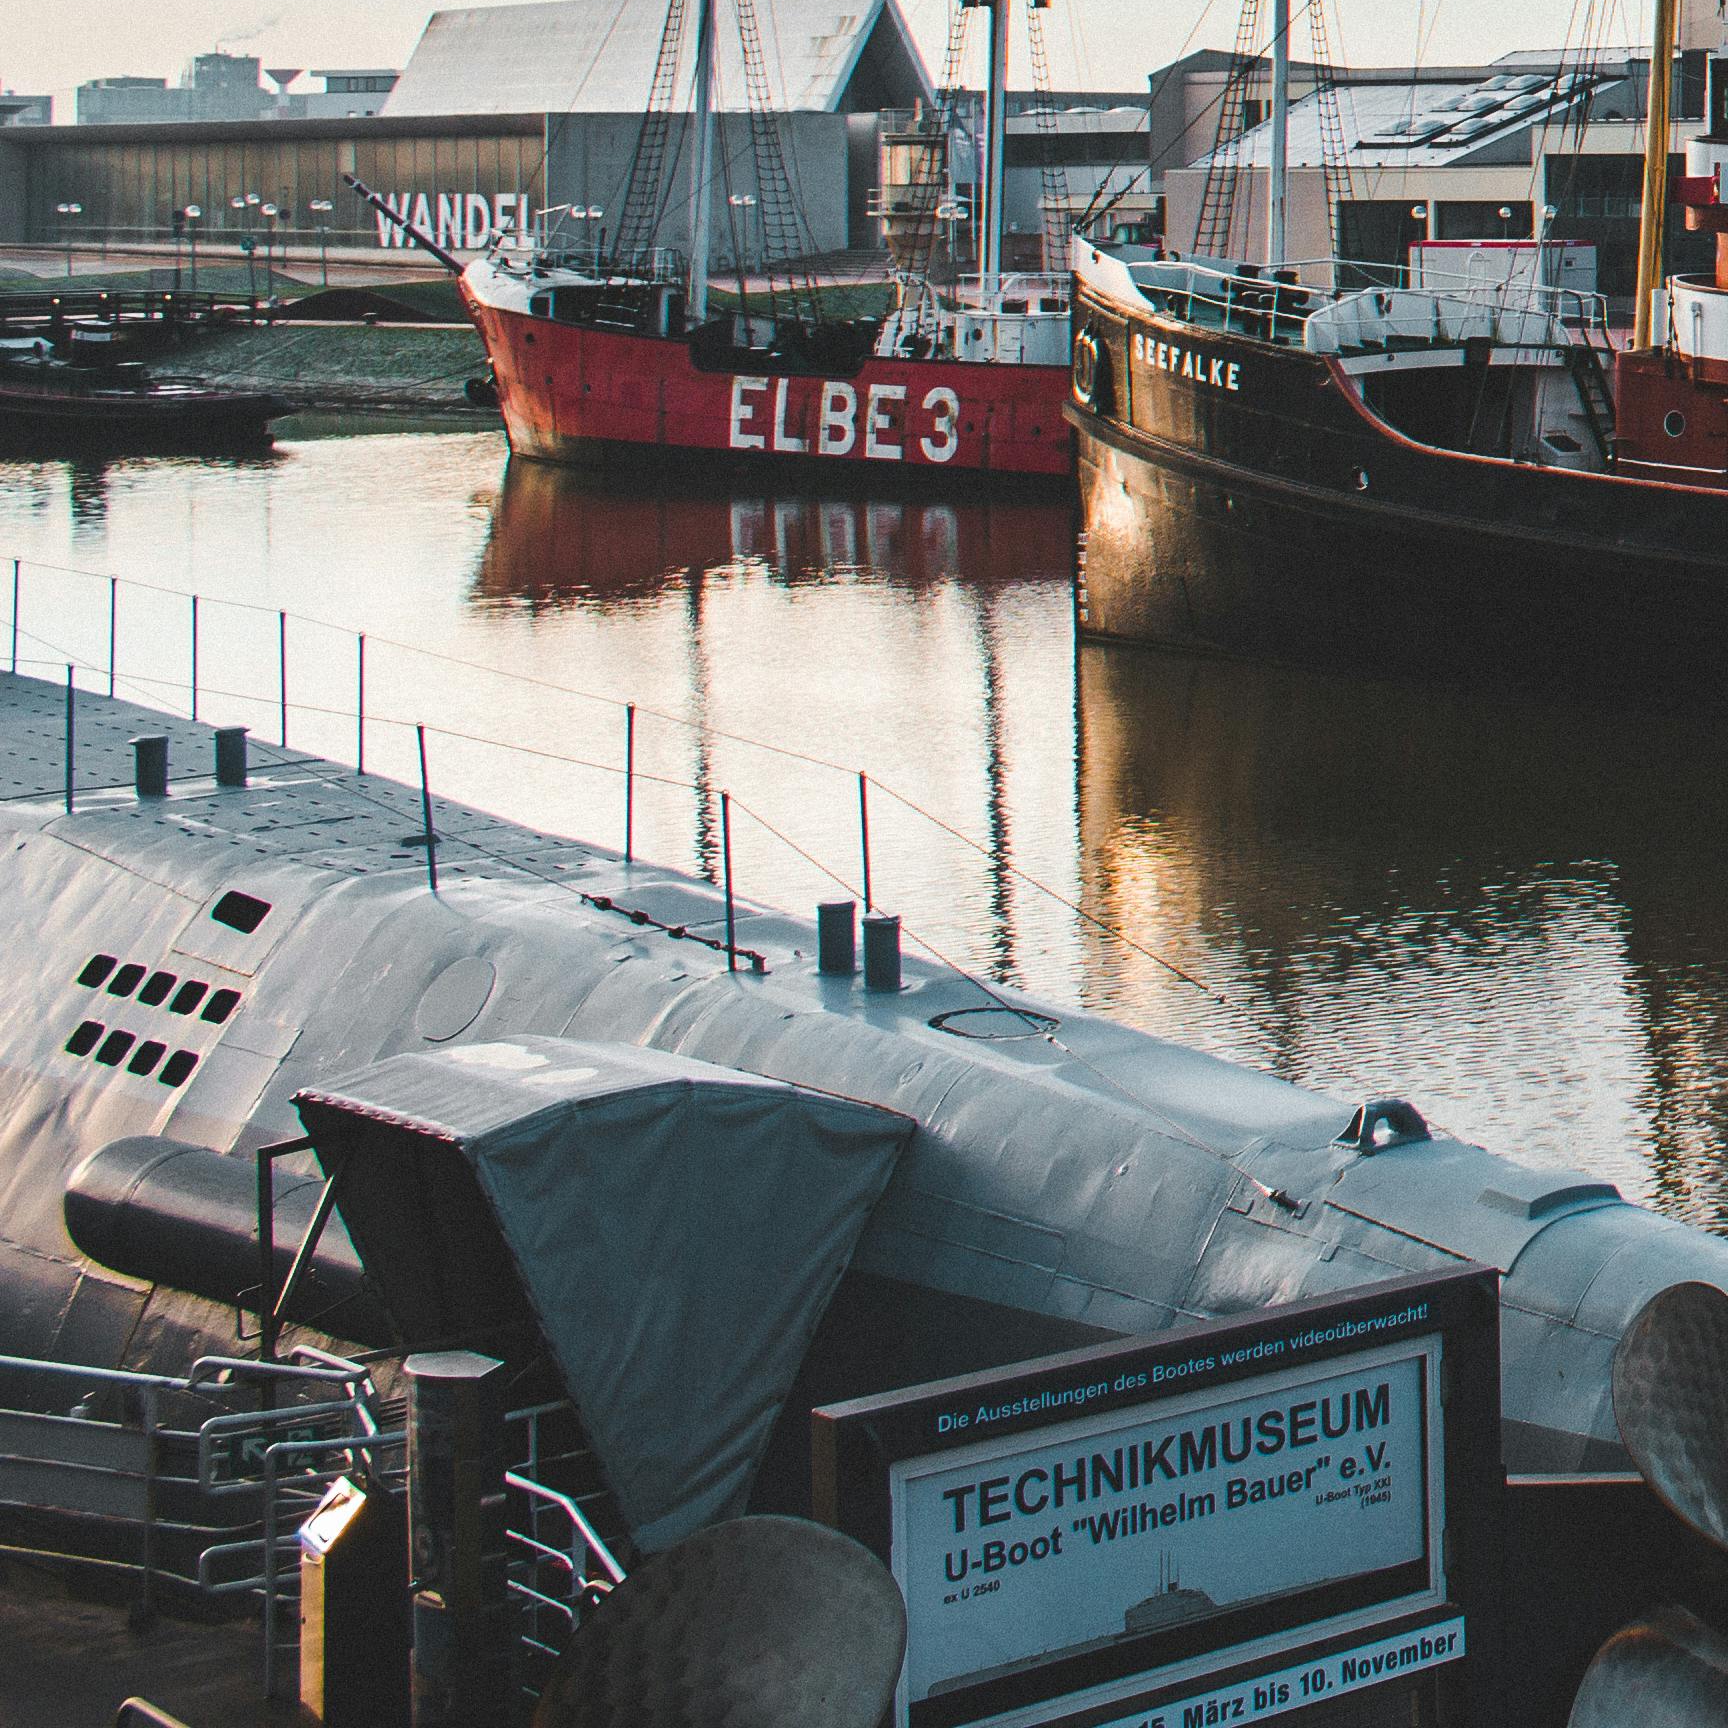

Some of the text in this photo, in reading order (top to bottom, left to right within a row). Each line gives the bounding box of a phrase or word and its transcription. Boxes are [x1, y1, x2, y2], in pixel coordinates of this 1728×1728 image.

[373, 192, 536, 249] WANDEL
[1134, 333, 1240, 391] SEEFALKE
[730, 375, 960, 462] ELBE 3
[938, 1303, 1428, 1433] Die Ausstellungen des Bootes werden videoüberwacht!
[943, 1383, 1391, 1533] TECHNIKMUSEUM
[1315, 1488, 1351, 1506] U-Boot
[1354, 1483, 1371, 1497] Typ
[945, 1441, 1391, 1582] U-Boot "Wilhelm Bauer" e.V.
[944, 1593, 958, 1605] ex
[961, 1587, 970, 1600] U
[1183, 1696, 1245, 1728] März
[1253, 1683, 1290, 1711] bis
[1300, 1668, 1333, 1696] 10.
[1342, 1632, 1458, 1684] November
